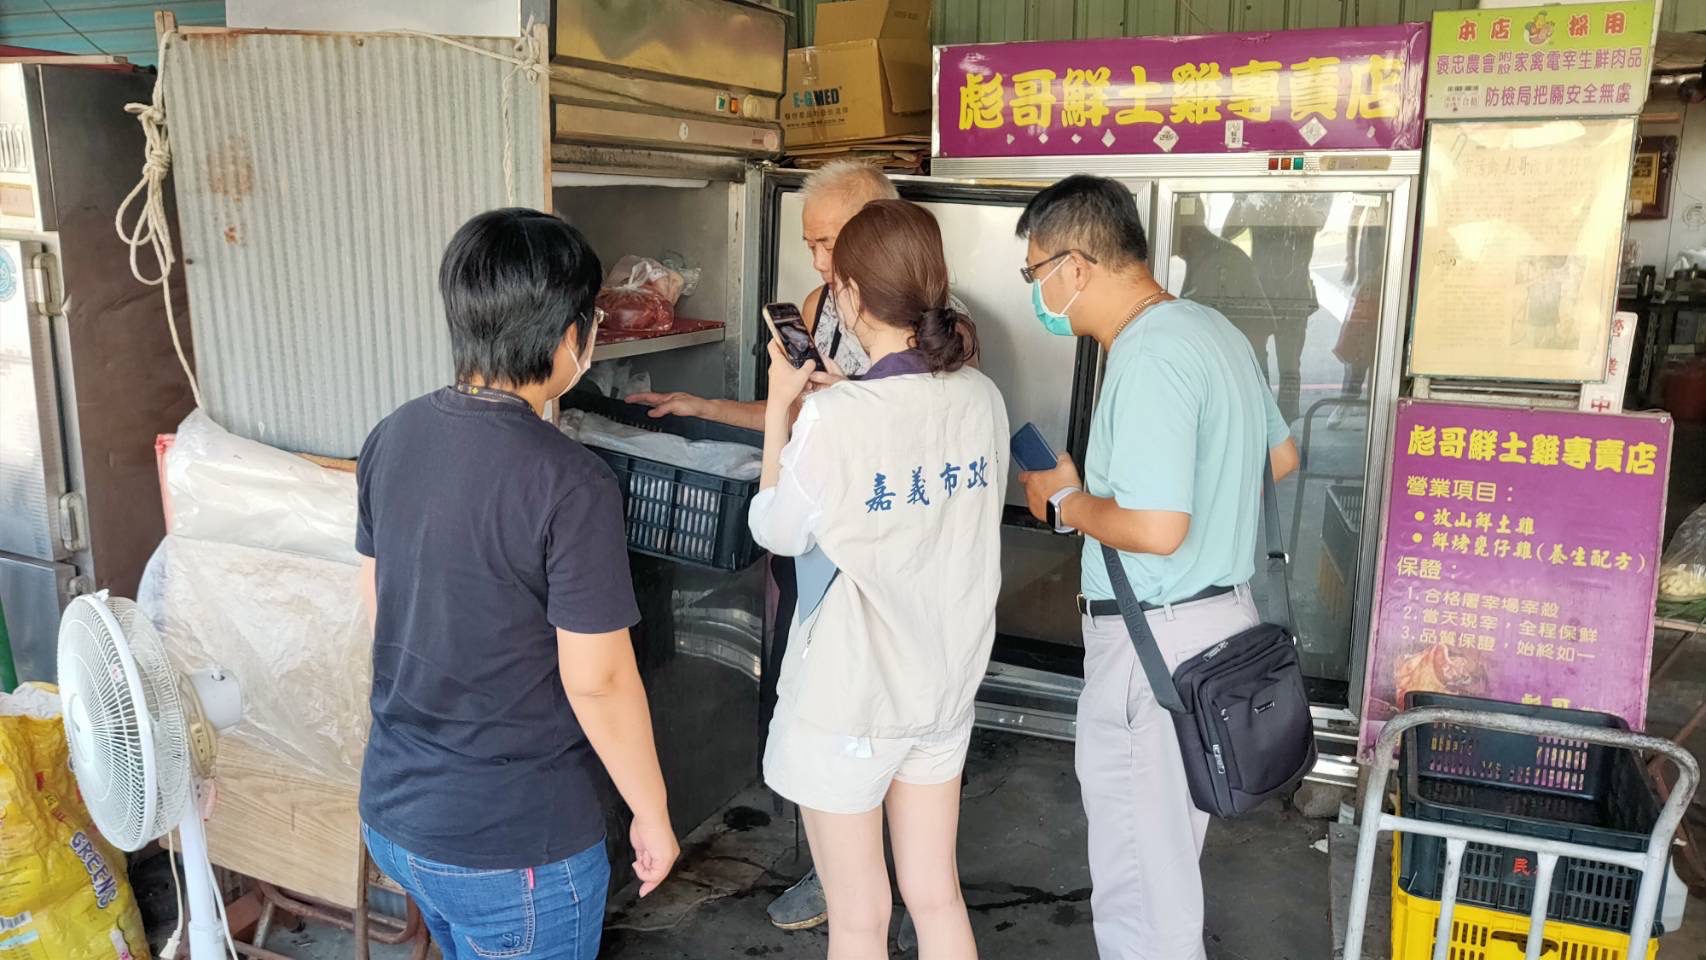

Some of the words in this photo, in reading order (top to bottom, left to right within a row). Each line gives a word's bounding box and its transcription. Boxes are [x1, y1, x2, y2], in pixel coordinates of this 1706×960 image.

[1457, 18, 1512, 41] 本店
[1568, 12, 1626, 38] 採用
[958, 55, 1405, 131] 彪哥鮮土雞專賣店
[1407, 424, 1659, 476] 彪哥鮮土雞專賣店
[865, 455, 988, 514] 嘉義市政
[70, 830, 119, 910] GREENS
